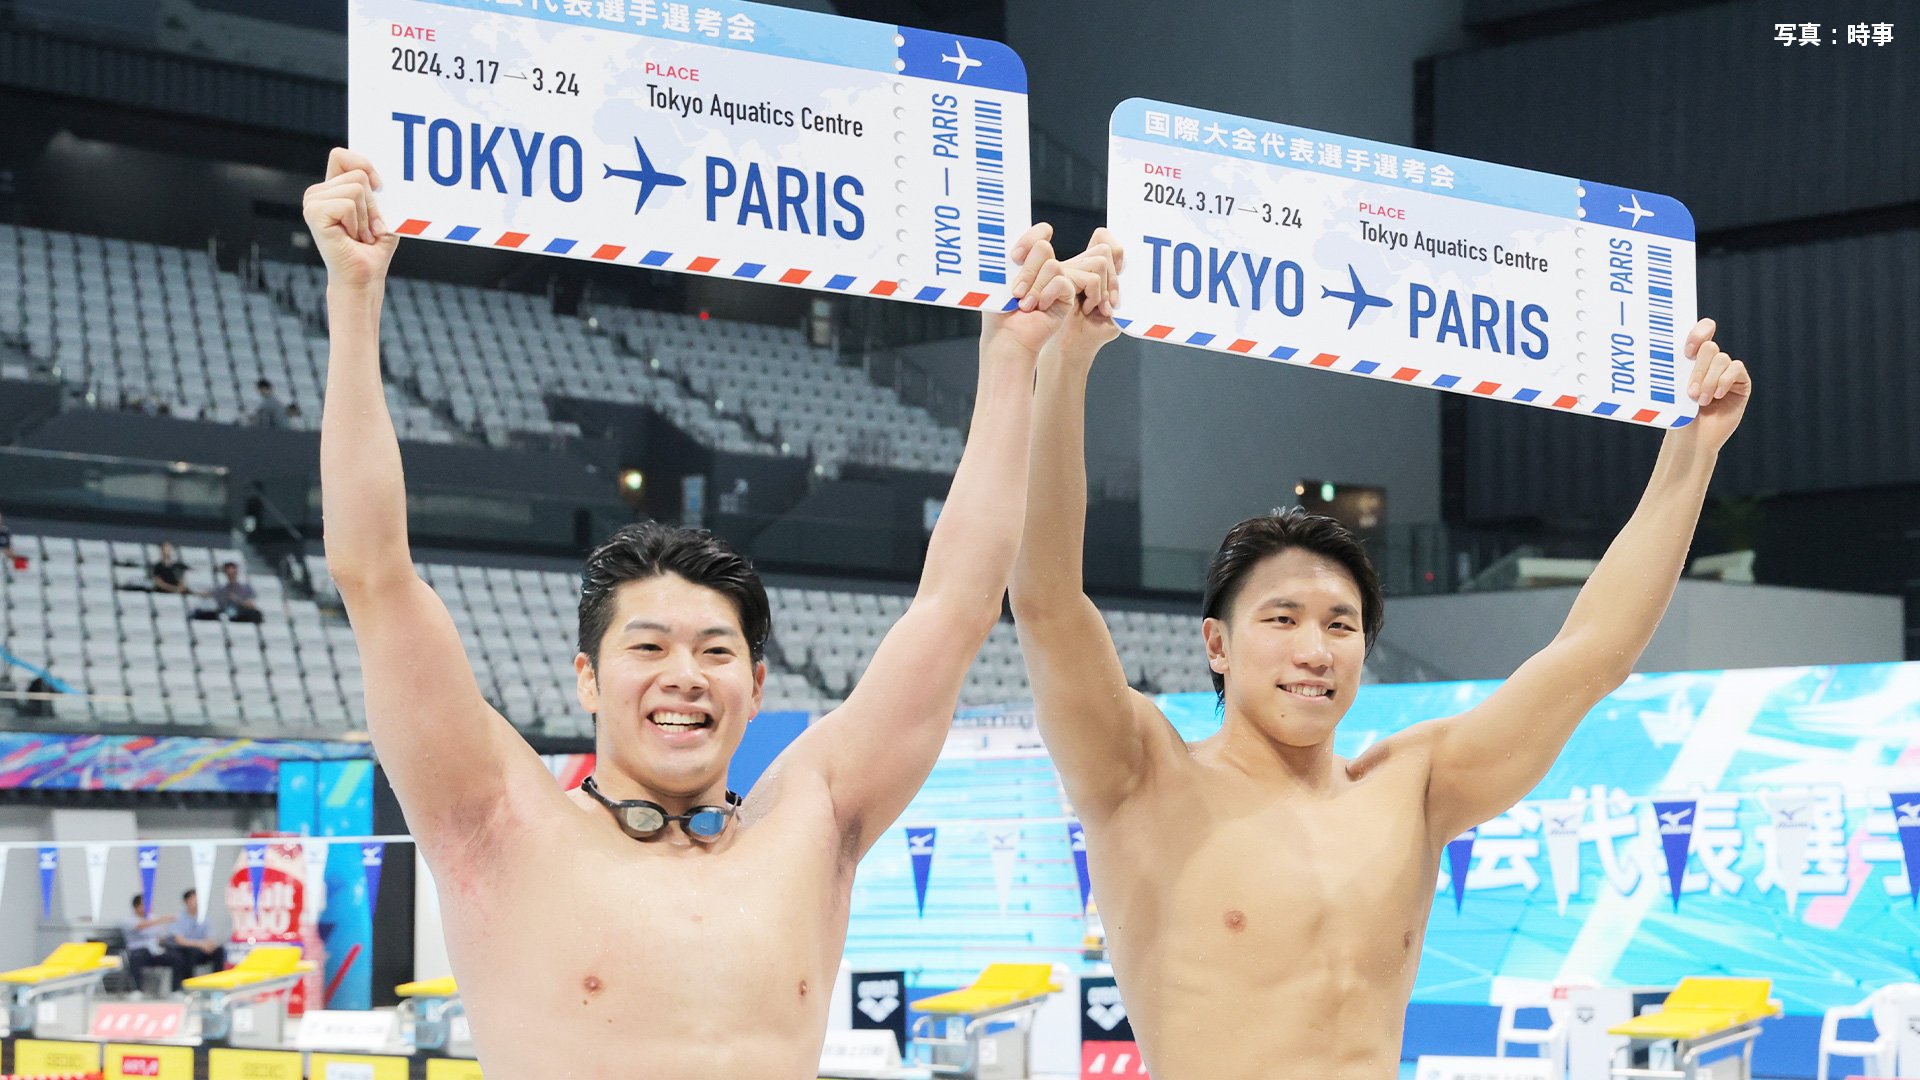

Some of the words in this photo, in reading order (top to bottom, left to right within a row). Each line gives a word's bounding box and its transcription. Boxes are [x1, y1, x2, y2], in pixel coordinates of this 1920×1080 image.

[391, 24, 436, 42] DATE
[391, 47, 500, 84] 2024.3.17
[532, 68, 580, 97] 3.24
[645, 62, 700, 82] PLACE
[646, 83, 703, 118] Tokyo
[710, 94, 794, 128] Aquatics
[801, 107, 863, 138] Centre
[931, 93, 959, 159] PARIS
[392, 111, 583, 203] TOKYO
[706, 155, 865, 241] PARIS
[1144, 110, 1456, 189] 国際大会代表選手選考会
[1144, 163, 1182, 180] DATE
[1143, 182, 1235, 216] 2024.3.17
[1262, 203, 1302, 229] 3.24
[1359, 202, 1406, 220] PLACE
[934, 205, 962, 276] TOKYO
[1360, 220, 1408, 250] Tokyo
[1414, 231, 1488, 262] Aquatics
[1494, 245, 1548, 273] Centre
[1609, 238, 1634, 294] PARIS
[1143, 235, 1304, 318] TOKYO
[1409, 282, 1549, 360] PARIS
[1611, 333, 1636, 395] TOKYO
